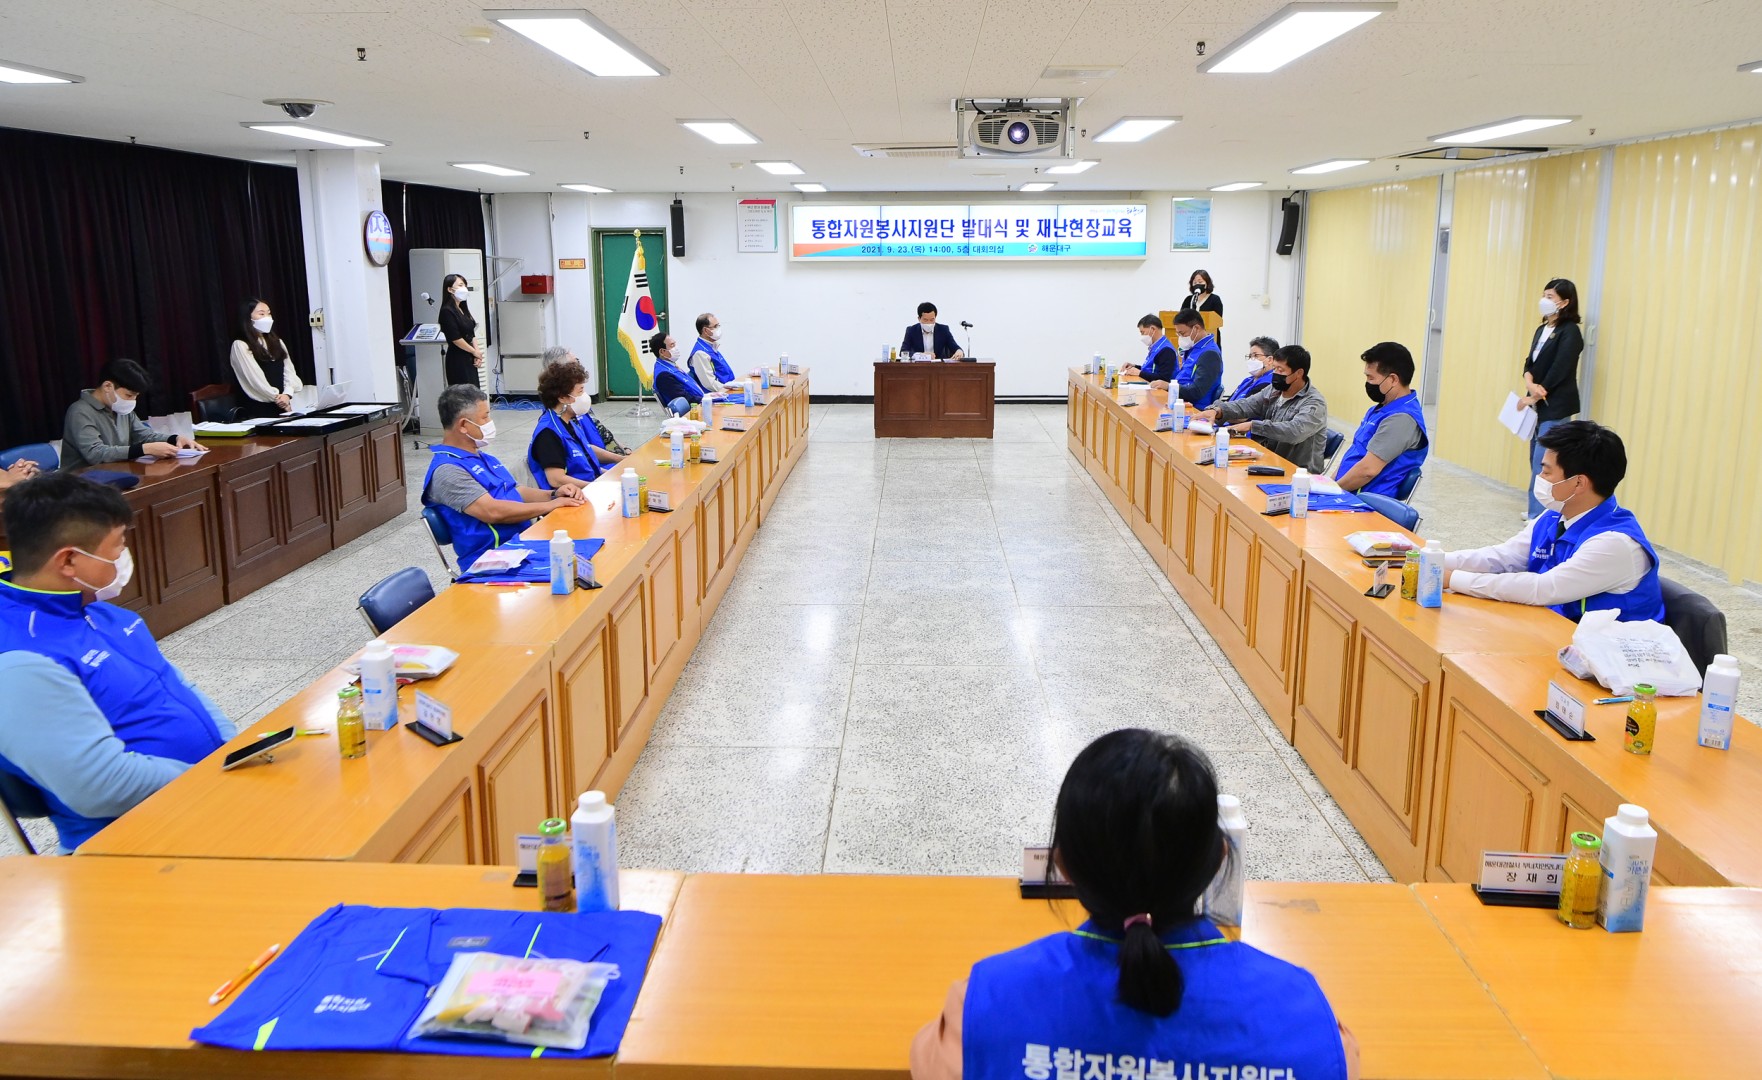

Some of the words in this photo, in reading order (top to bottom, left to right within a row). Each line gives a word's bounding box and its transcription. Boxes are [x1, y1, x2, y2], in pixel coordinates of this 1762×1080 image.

[811, 218, 955, 240] 통합자원봉사지원단
[961, 218, 1008, 239] 발대식
[1015, 218, 1030, 239] 및
[1036, 217, 1133, 239] 재난현장교육
[973, 245, 1005, 254] 대회의실
[1041, 244, 1072, 253] 해운대구
